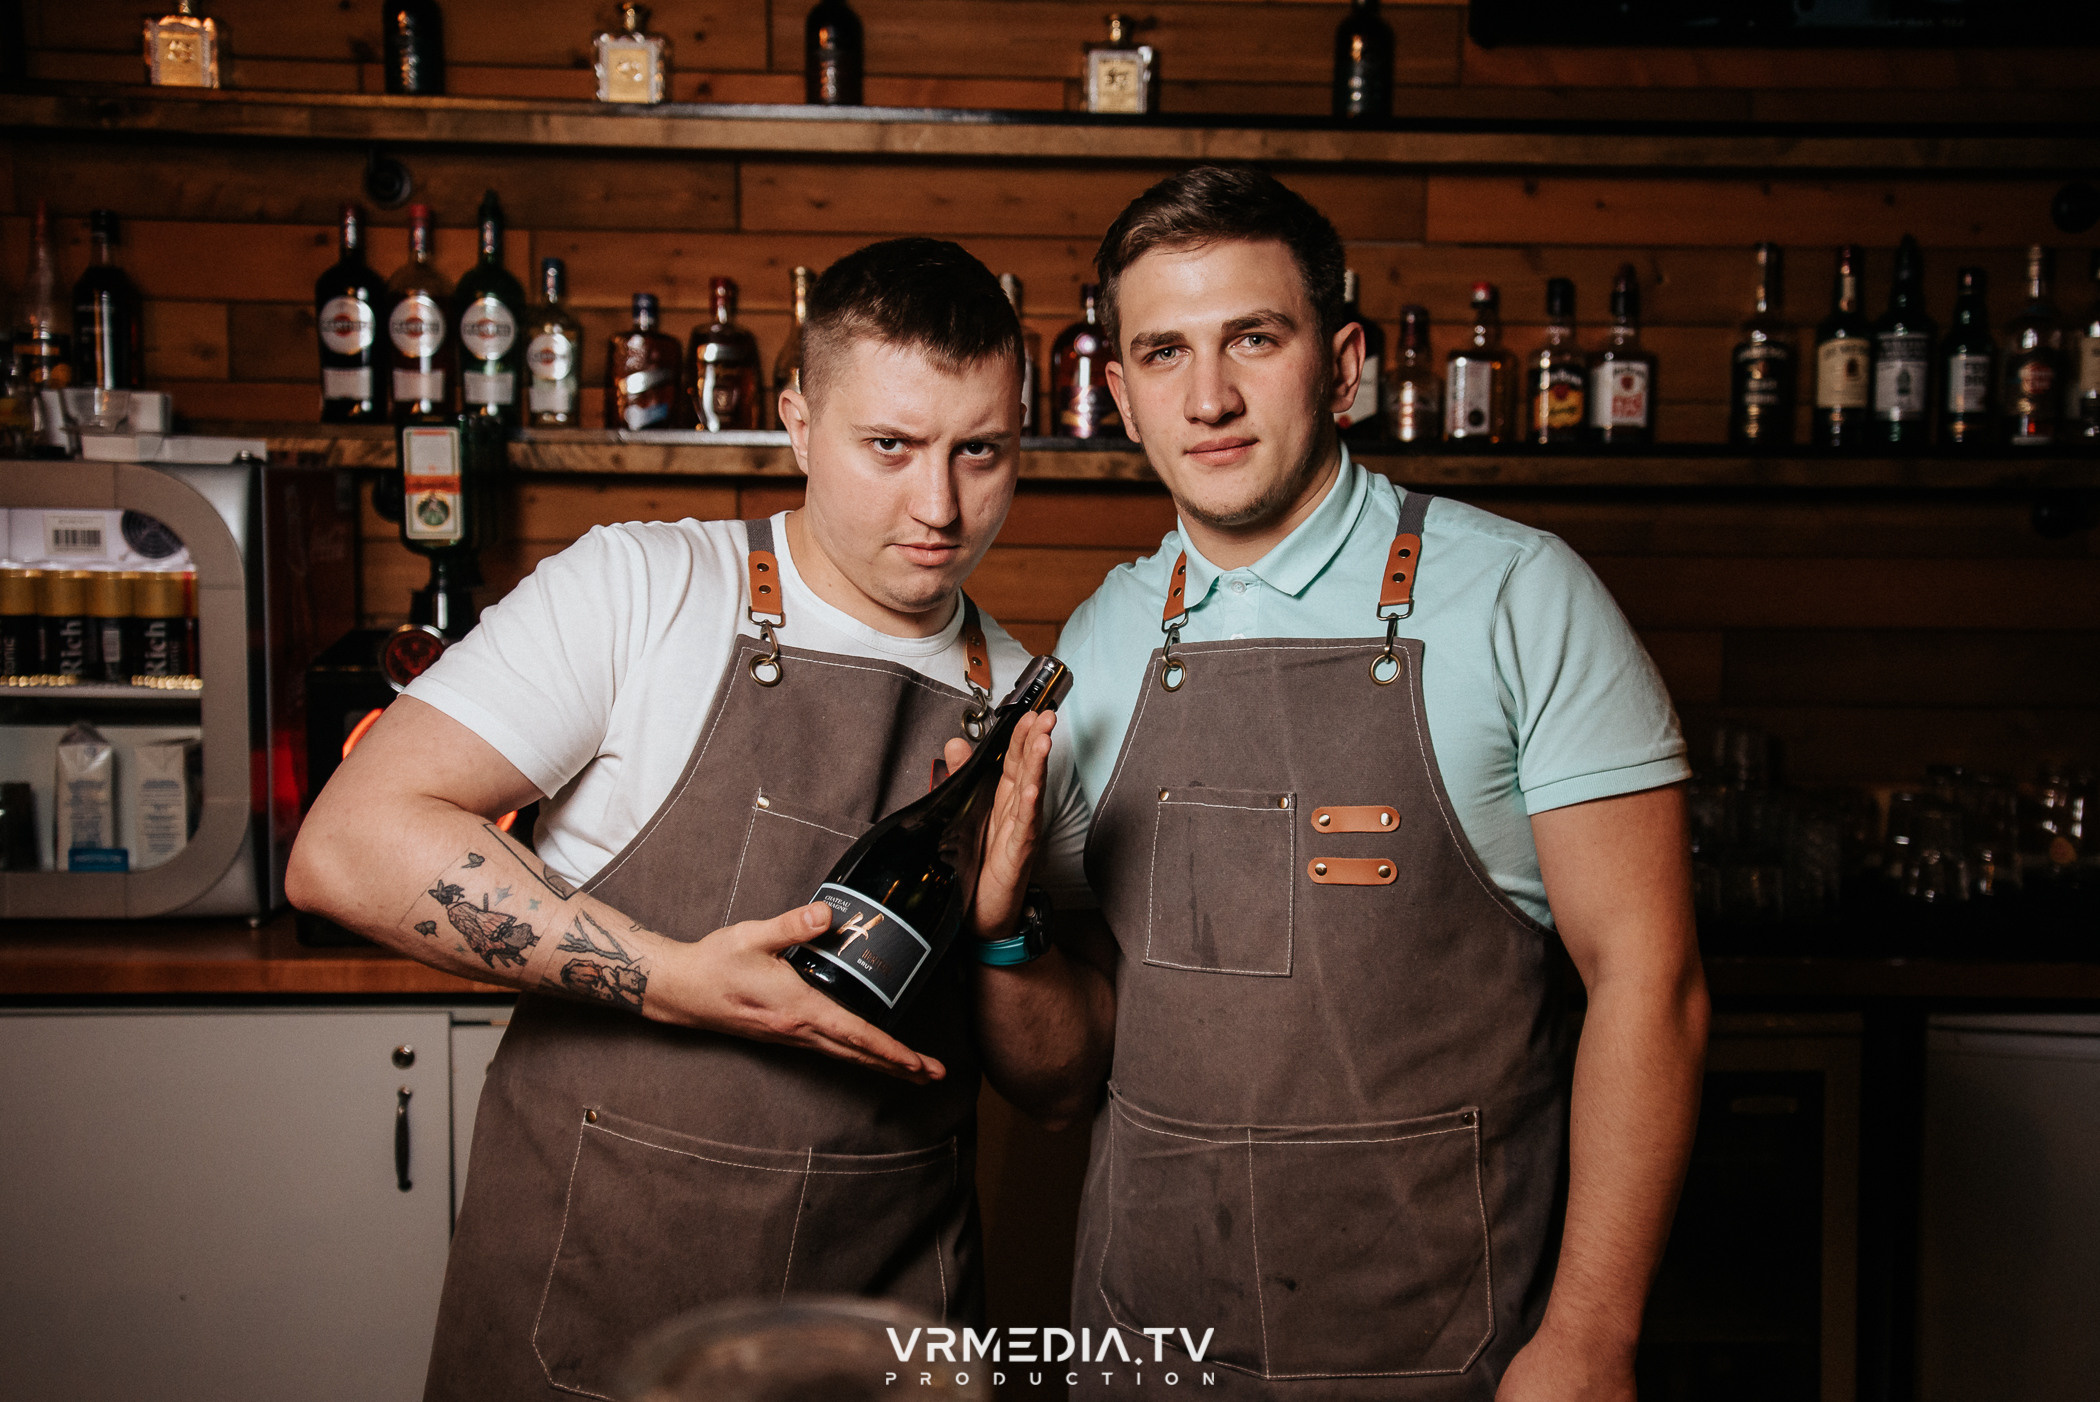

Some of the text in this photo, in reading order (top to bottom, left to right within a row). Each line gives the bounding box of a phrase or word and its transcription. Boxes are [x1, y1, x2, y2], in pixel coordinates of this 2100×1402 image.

[60, 620, 82, 676] Rich
[145, 621, 167, 677] Rich
[824, 895, 851, 908] CHATEAU
[857, 958, 873, 972] BRUT
